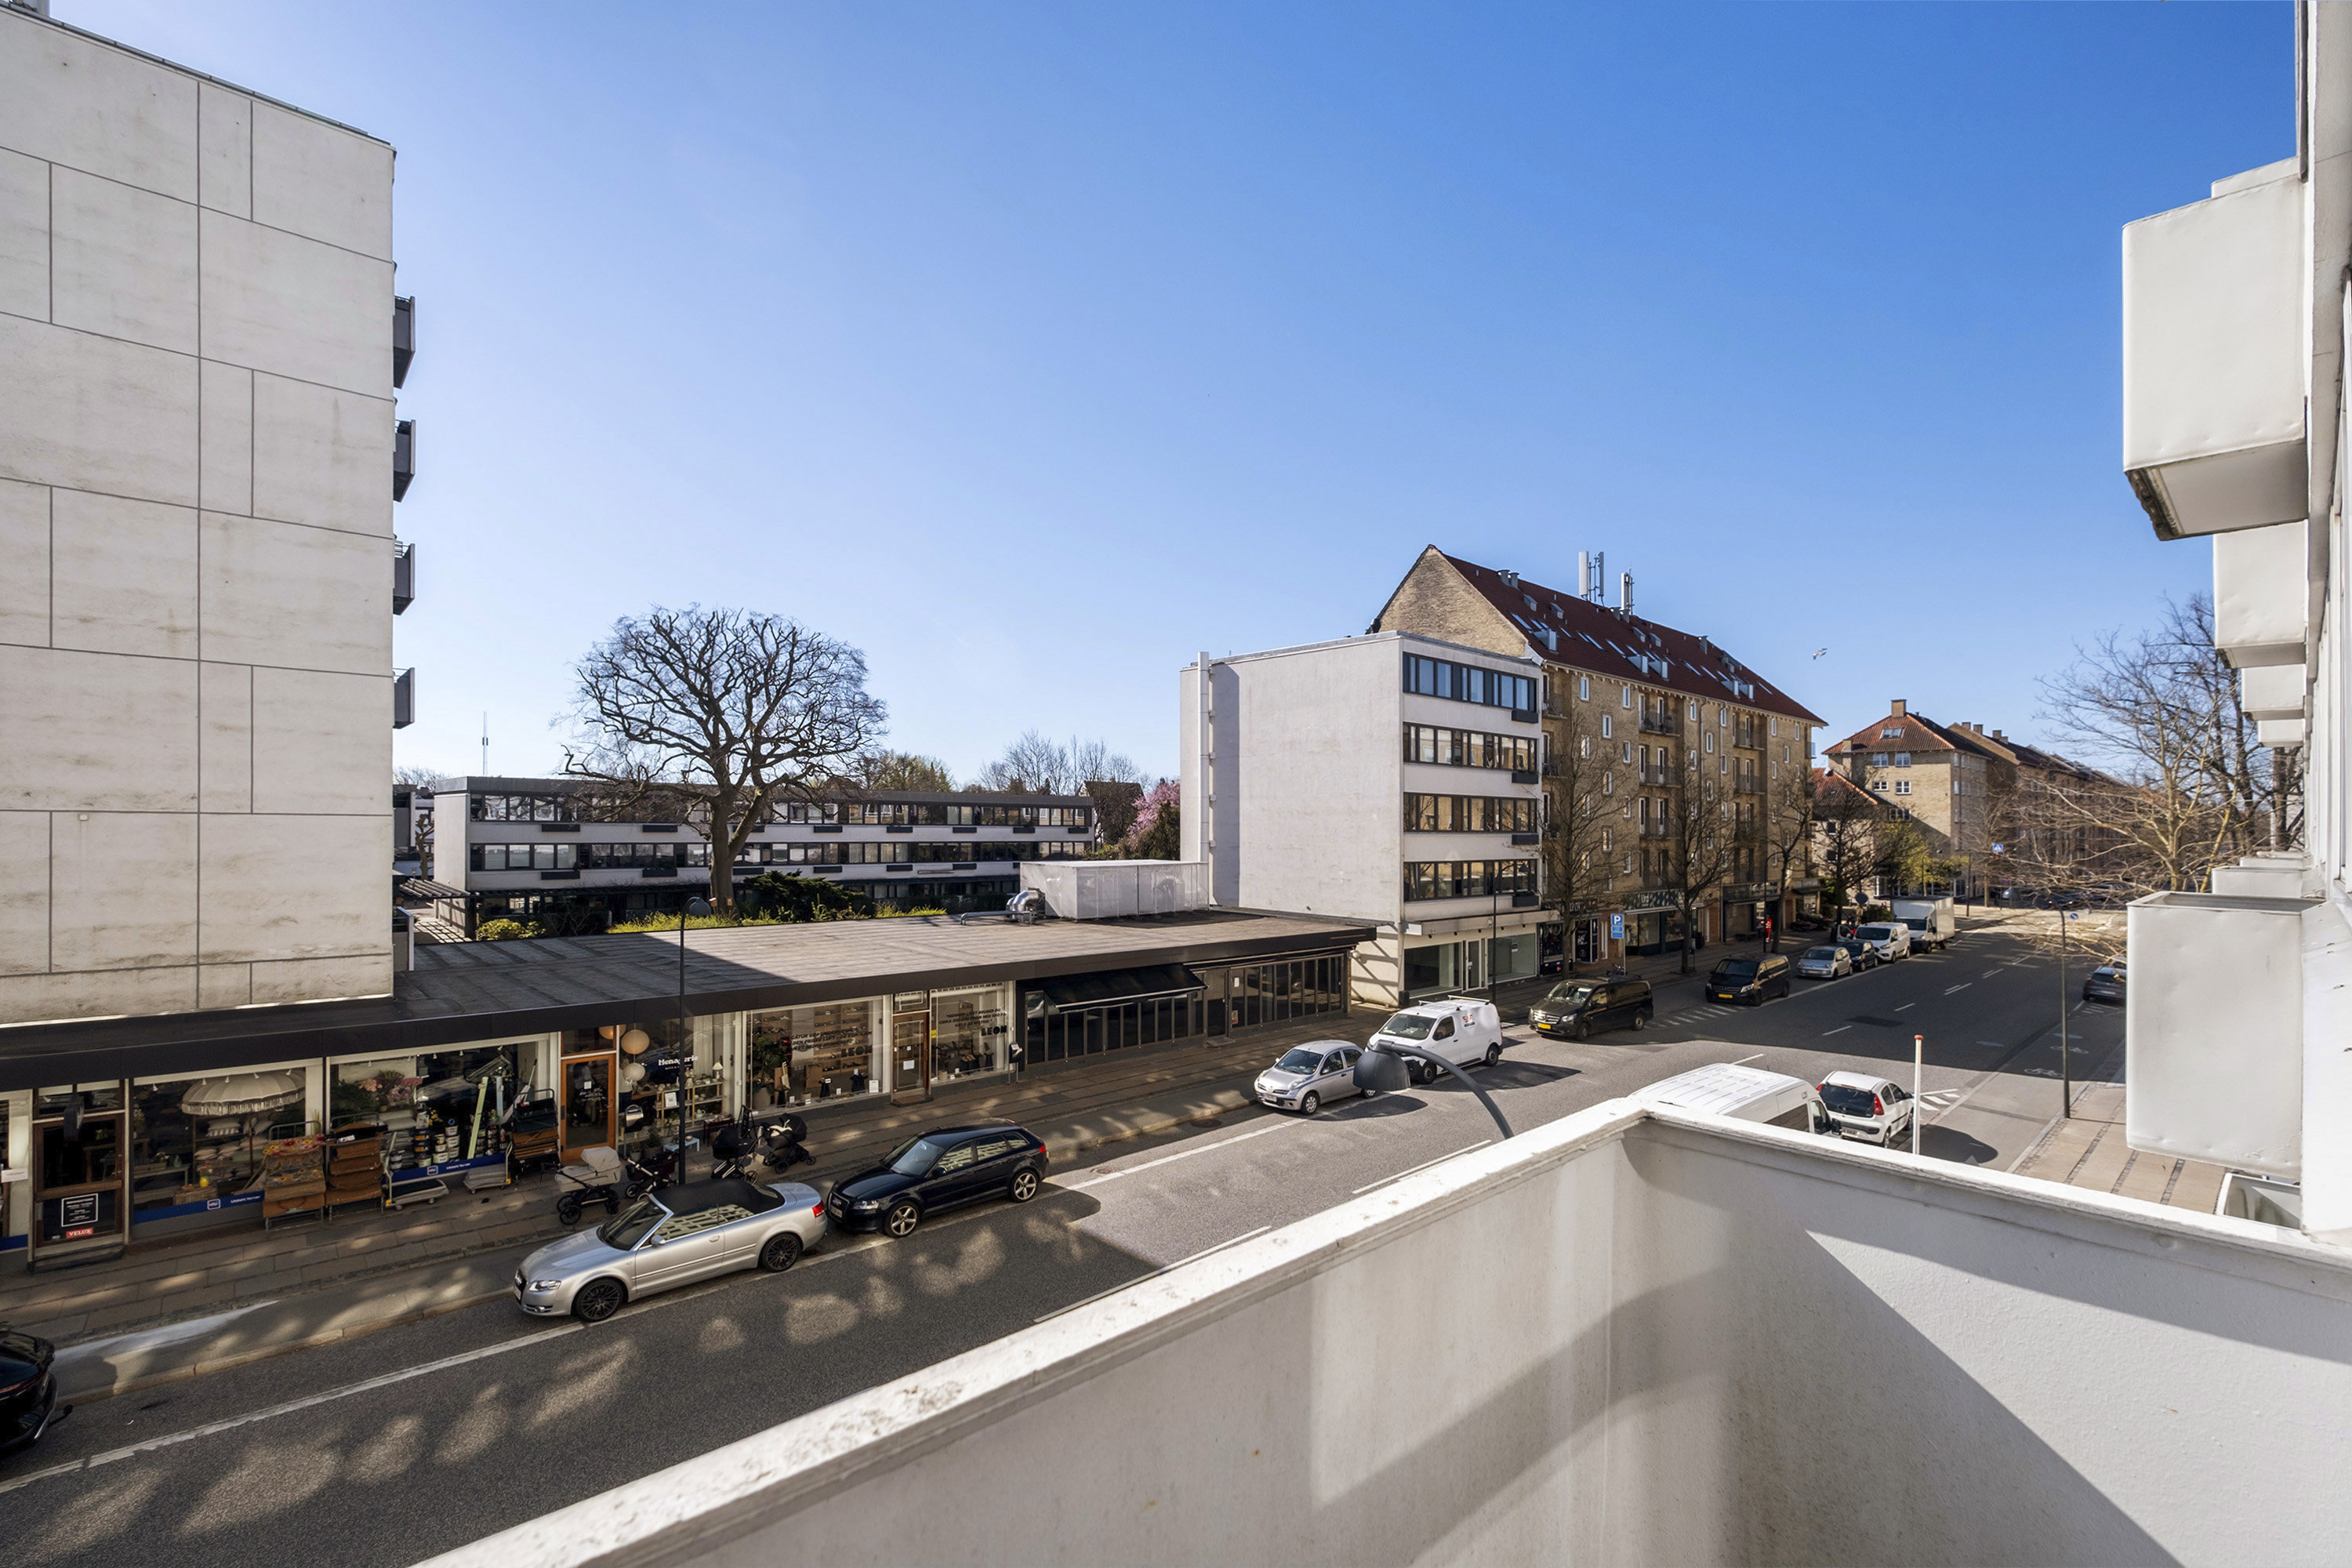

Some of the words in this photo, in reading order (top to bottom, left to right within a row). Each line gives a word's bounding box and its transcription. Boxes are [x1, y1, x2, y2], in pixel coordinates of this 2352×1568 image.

[1614, 915, 1621, 924] P
[982, 1025, 1007, 1036] LEON
[840, 1044, 873, 1058] LEON
